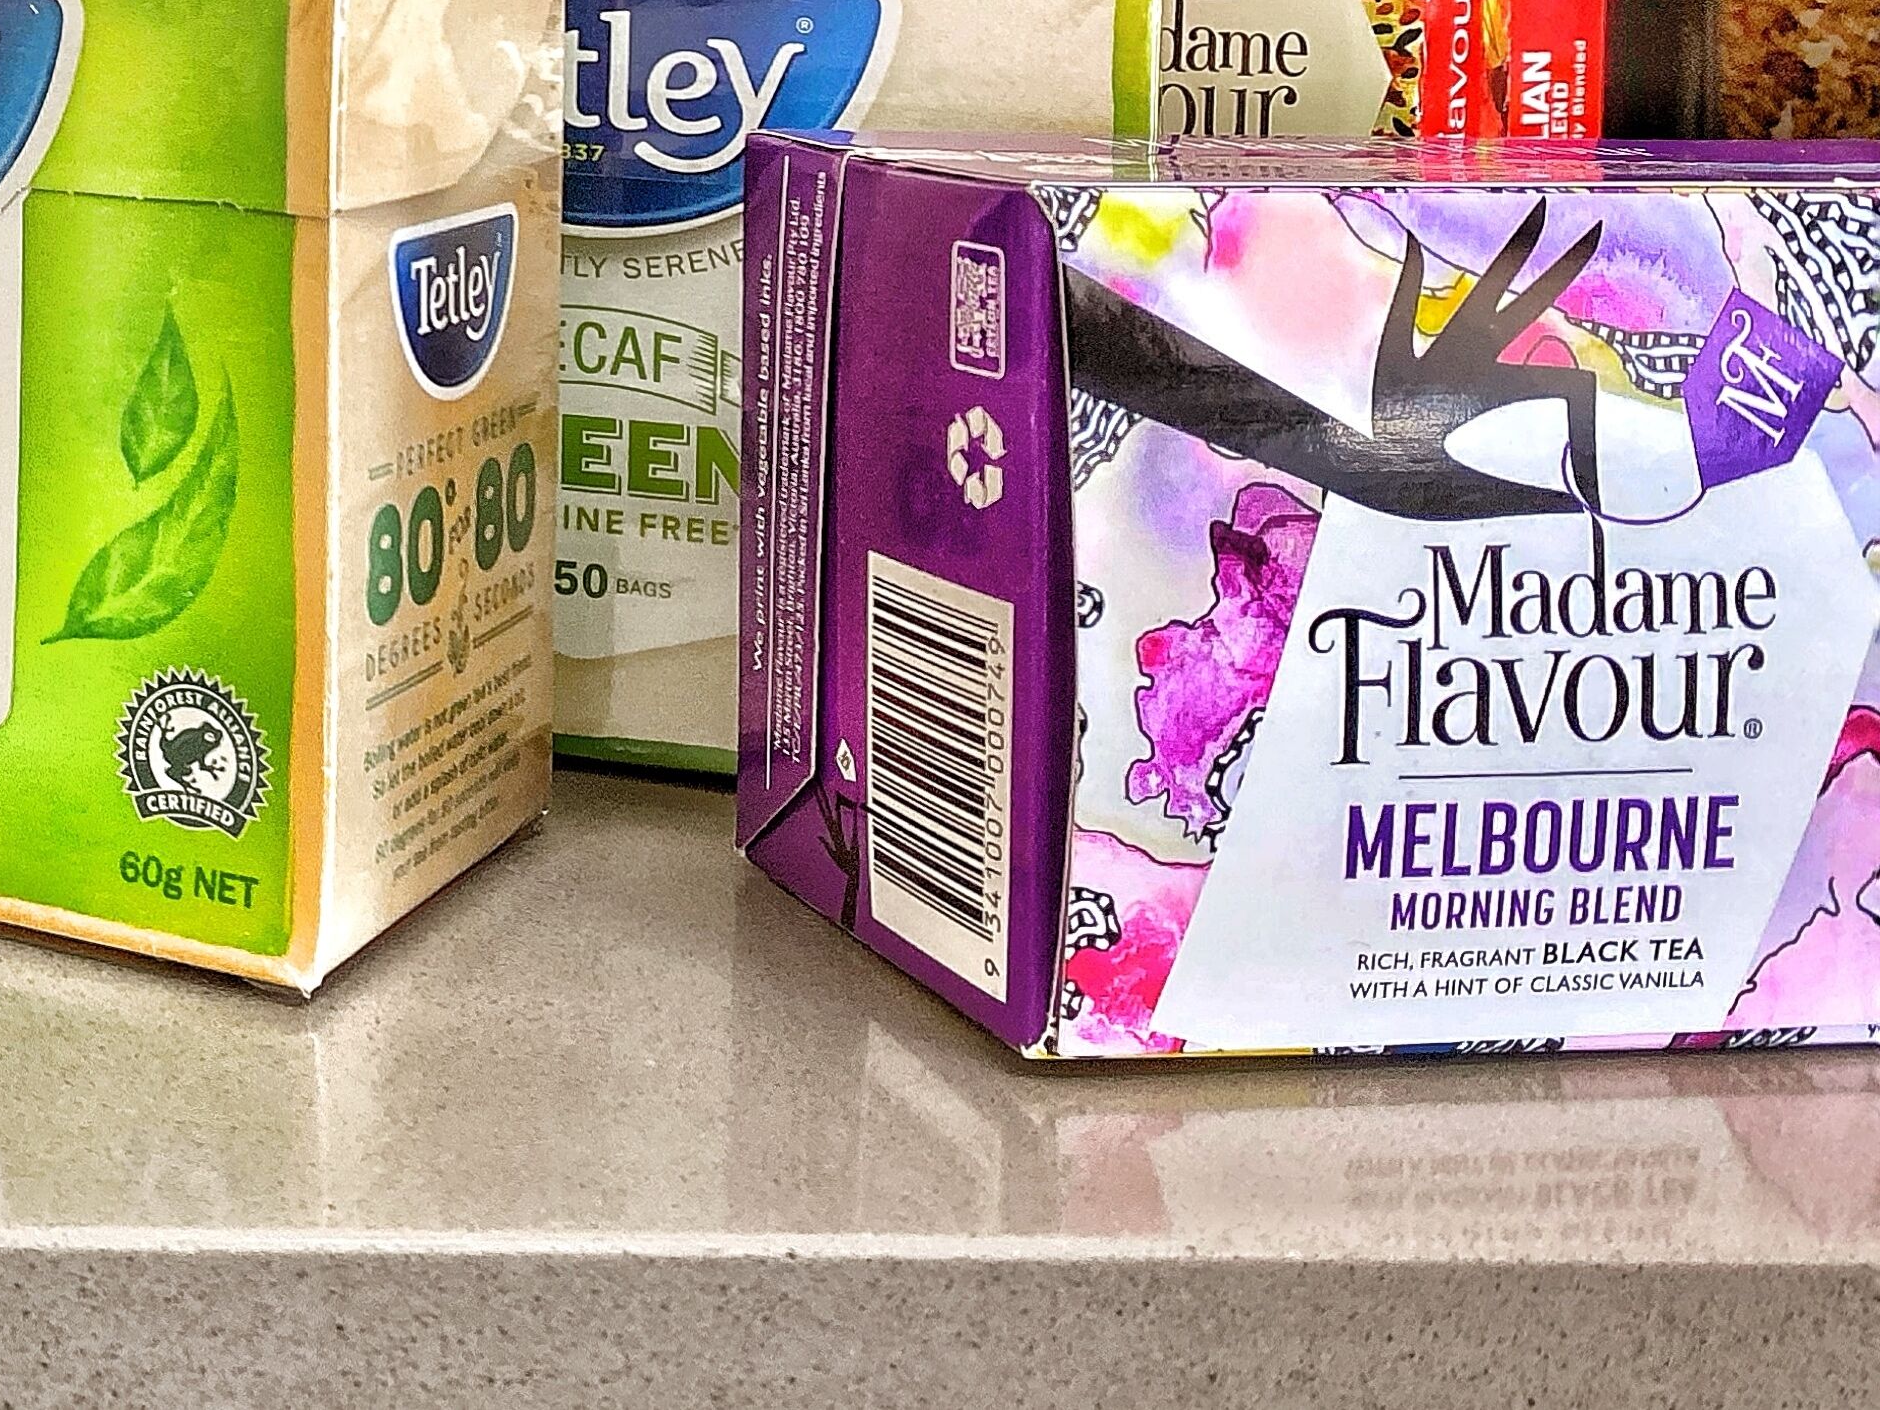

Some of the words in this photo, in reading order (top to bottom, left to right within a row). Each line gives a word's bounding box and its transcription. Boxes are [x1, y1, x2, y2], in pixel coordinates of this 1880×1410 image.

[563, 9, 806, 174] tley
[1520, 51, 1553, 139] LIAN
[1572, 39, 1588, 117] Blended
[1551, 81, 1570, 139] END
[560, 143, 605, 162] 837
[410, 245, 500, 341] Tetley
[560, 253, 608, 279] TLY
[759, 254, 773, 306] inks.
[560, 320, 682, 383] CAF
[757, 314, 772, 381] based
[561, 413, 742, 506] EEN
[755, 388, 770, 498] vegetable
[475, 442, 537, 572] 80
[754, 507, 766, 558] with
[554, 559, 609, 599] 50
[616, 577, 672, 600] BAGS
[753, 566, 767, 625] print
[1424, 524, 1778, 651] Madame
[752, 632, 764, 671] We
[1308, 586, 1766, 766] Flavour
[135, 691, 204, 762] RAINFOREST
[986, 636, 1006, 774] 000749
[145, 794, 236, 829] CERTIFIED
[1344, 793, 1741, 880] MELBOURNE
[119, 850, 185, 901] 60g
[193, 865, 260, 910] NET
[985, 792, 1003, 933] 341007
[1390, 887, 1556, 931] MORNING
[1568, 883, 1684, 926] BLEND
[984, 958, 1001, 978] 9
[1349, 979, 1409, 1000] WITH
[1412, 979, 1428, 998] A
[1435, 977, 1488, 997] HINT
[1495, 976, 1524, 995] OF
[1530, 972, 1617, 993] CLASSIC
[1619, 970, 1705, 991] VANILLA
[1357, 950, 1415, 972] RICH,
[1420, 946, 1536, 969] FRAGRANT
[1542, 938, 1642, 966] BLACK
[1648, 936, 1705, 961] TEA
